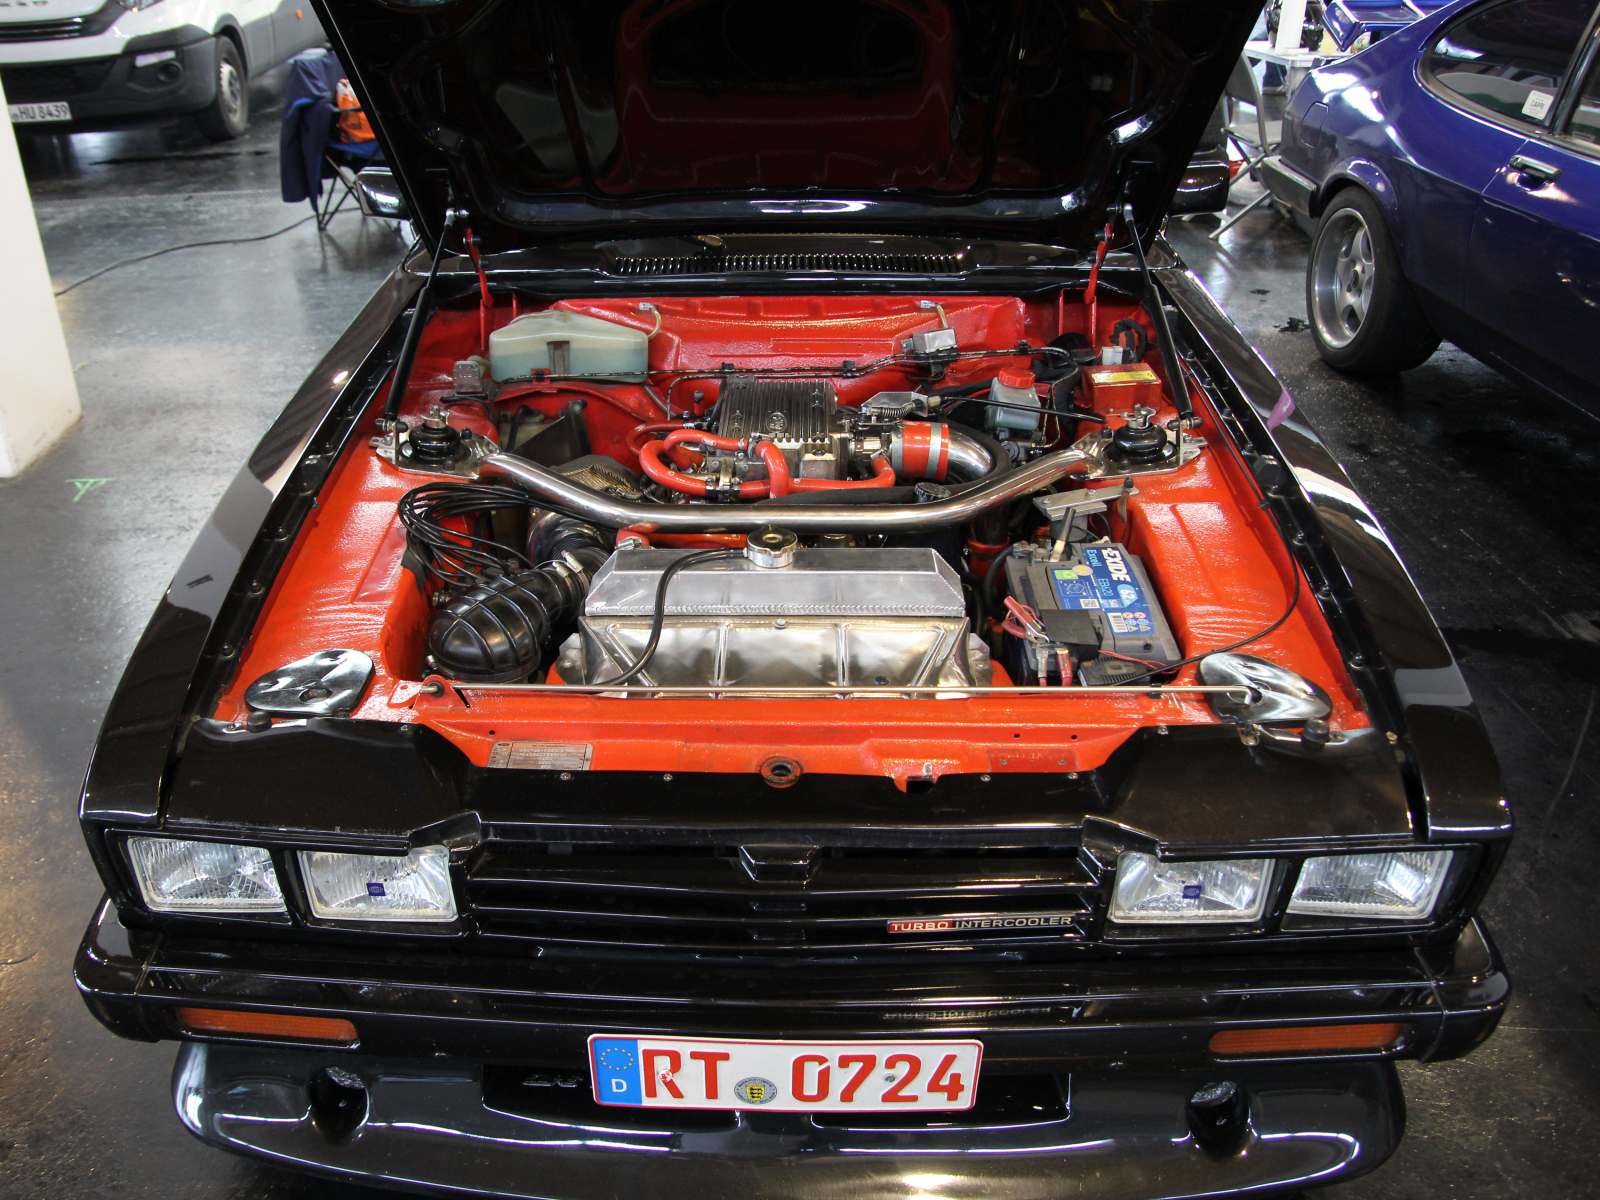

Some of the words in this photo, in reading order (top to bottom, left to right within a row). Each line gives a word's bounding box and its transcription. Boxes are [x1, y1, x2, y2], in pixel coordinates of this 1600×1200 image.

[18, 106, 36, 120] HU
[37, 104, 69, 119] 8439
[1530, 100, 1546, 110] CAPRI
[1086, 549, 1102, 567] Excell
[1101, 547, 1131, 583] EXIDE
[1098, 578, 1114, 597] EB620
[1119, 589, 1136, 600] 62
[891, 921, 949, 931] TURBO
[955, 916, 1072, 929] INTERCOOLER
[642, 1048, 731, 1100] RT
[791, 1053, 965, 1103] 0724
[611, 1078, 627, 1093] D
